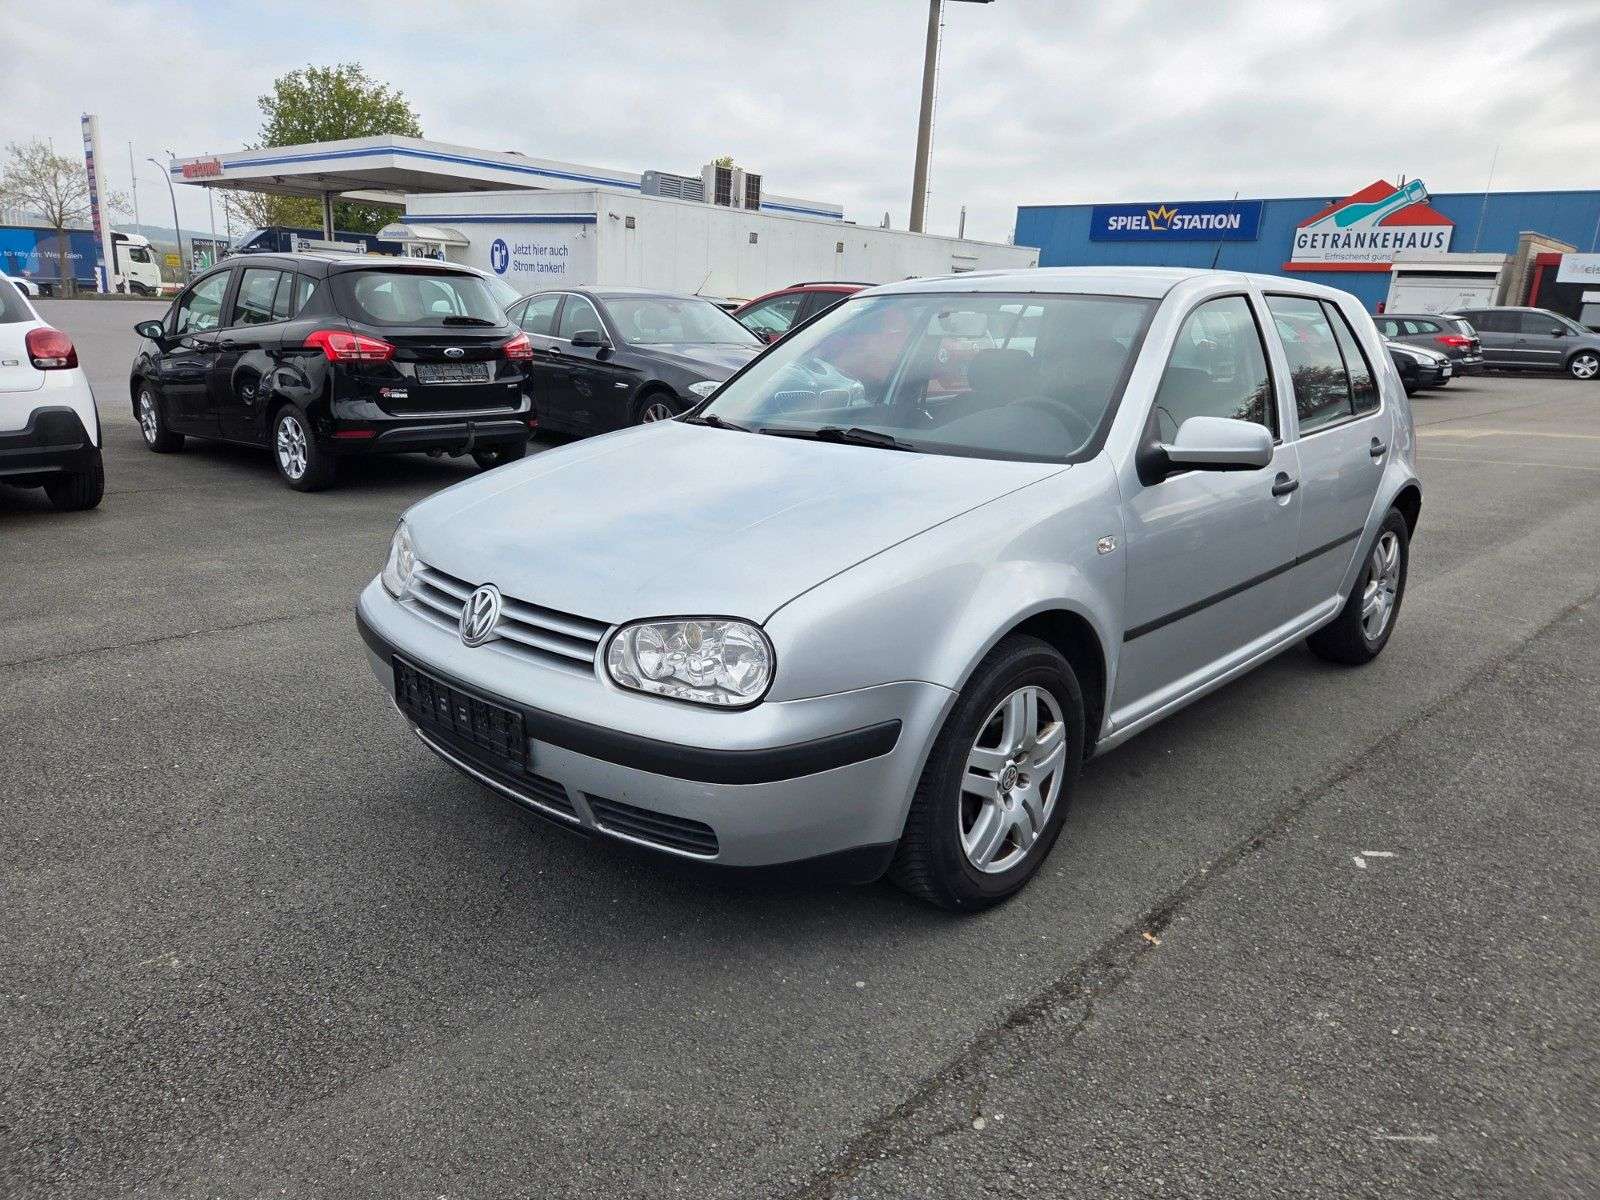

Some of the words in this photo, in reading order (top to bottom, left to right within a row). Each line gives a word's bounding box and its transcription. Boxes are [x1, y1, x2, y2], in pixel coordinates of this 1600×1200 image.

[1108, 215, 1149, 230] SPIEL
[1172, 214, 1241, 229] STATION
[1297, 228, 1445, 249] GETRÄNKEHAUS
[513, 244, 532, 255] Jetzt
[533, 244, 547, 256] hier
[549, 245, 569, 256] auch
[514, 260, 536, 272] Strom
[537, 262, 566, 273] tanken!
